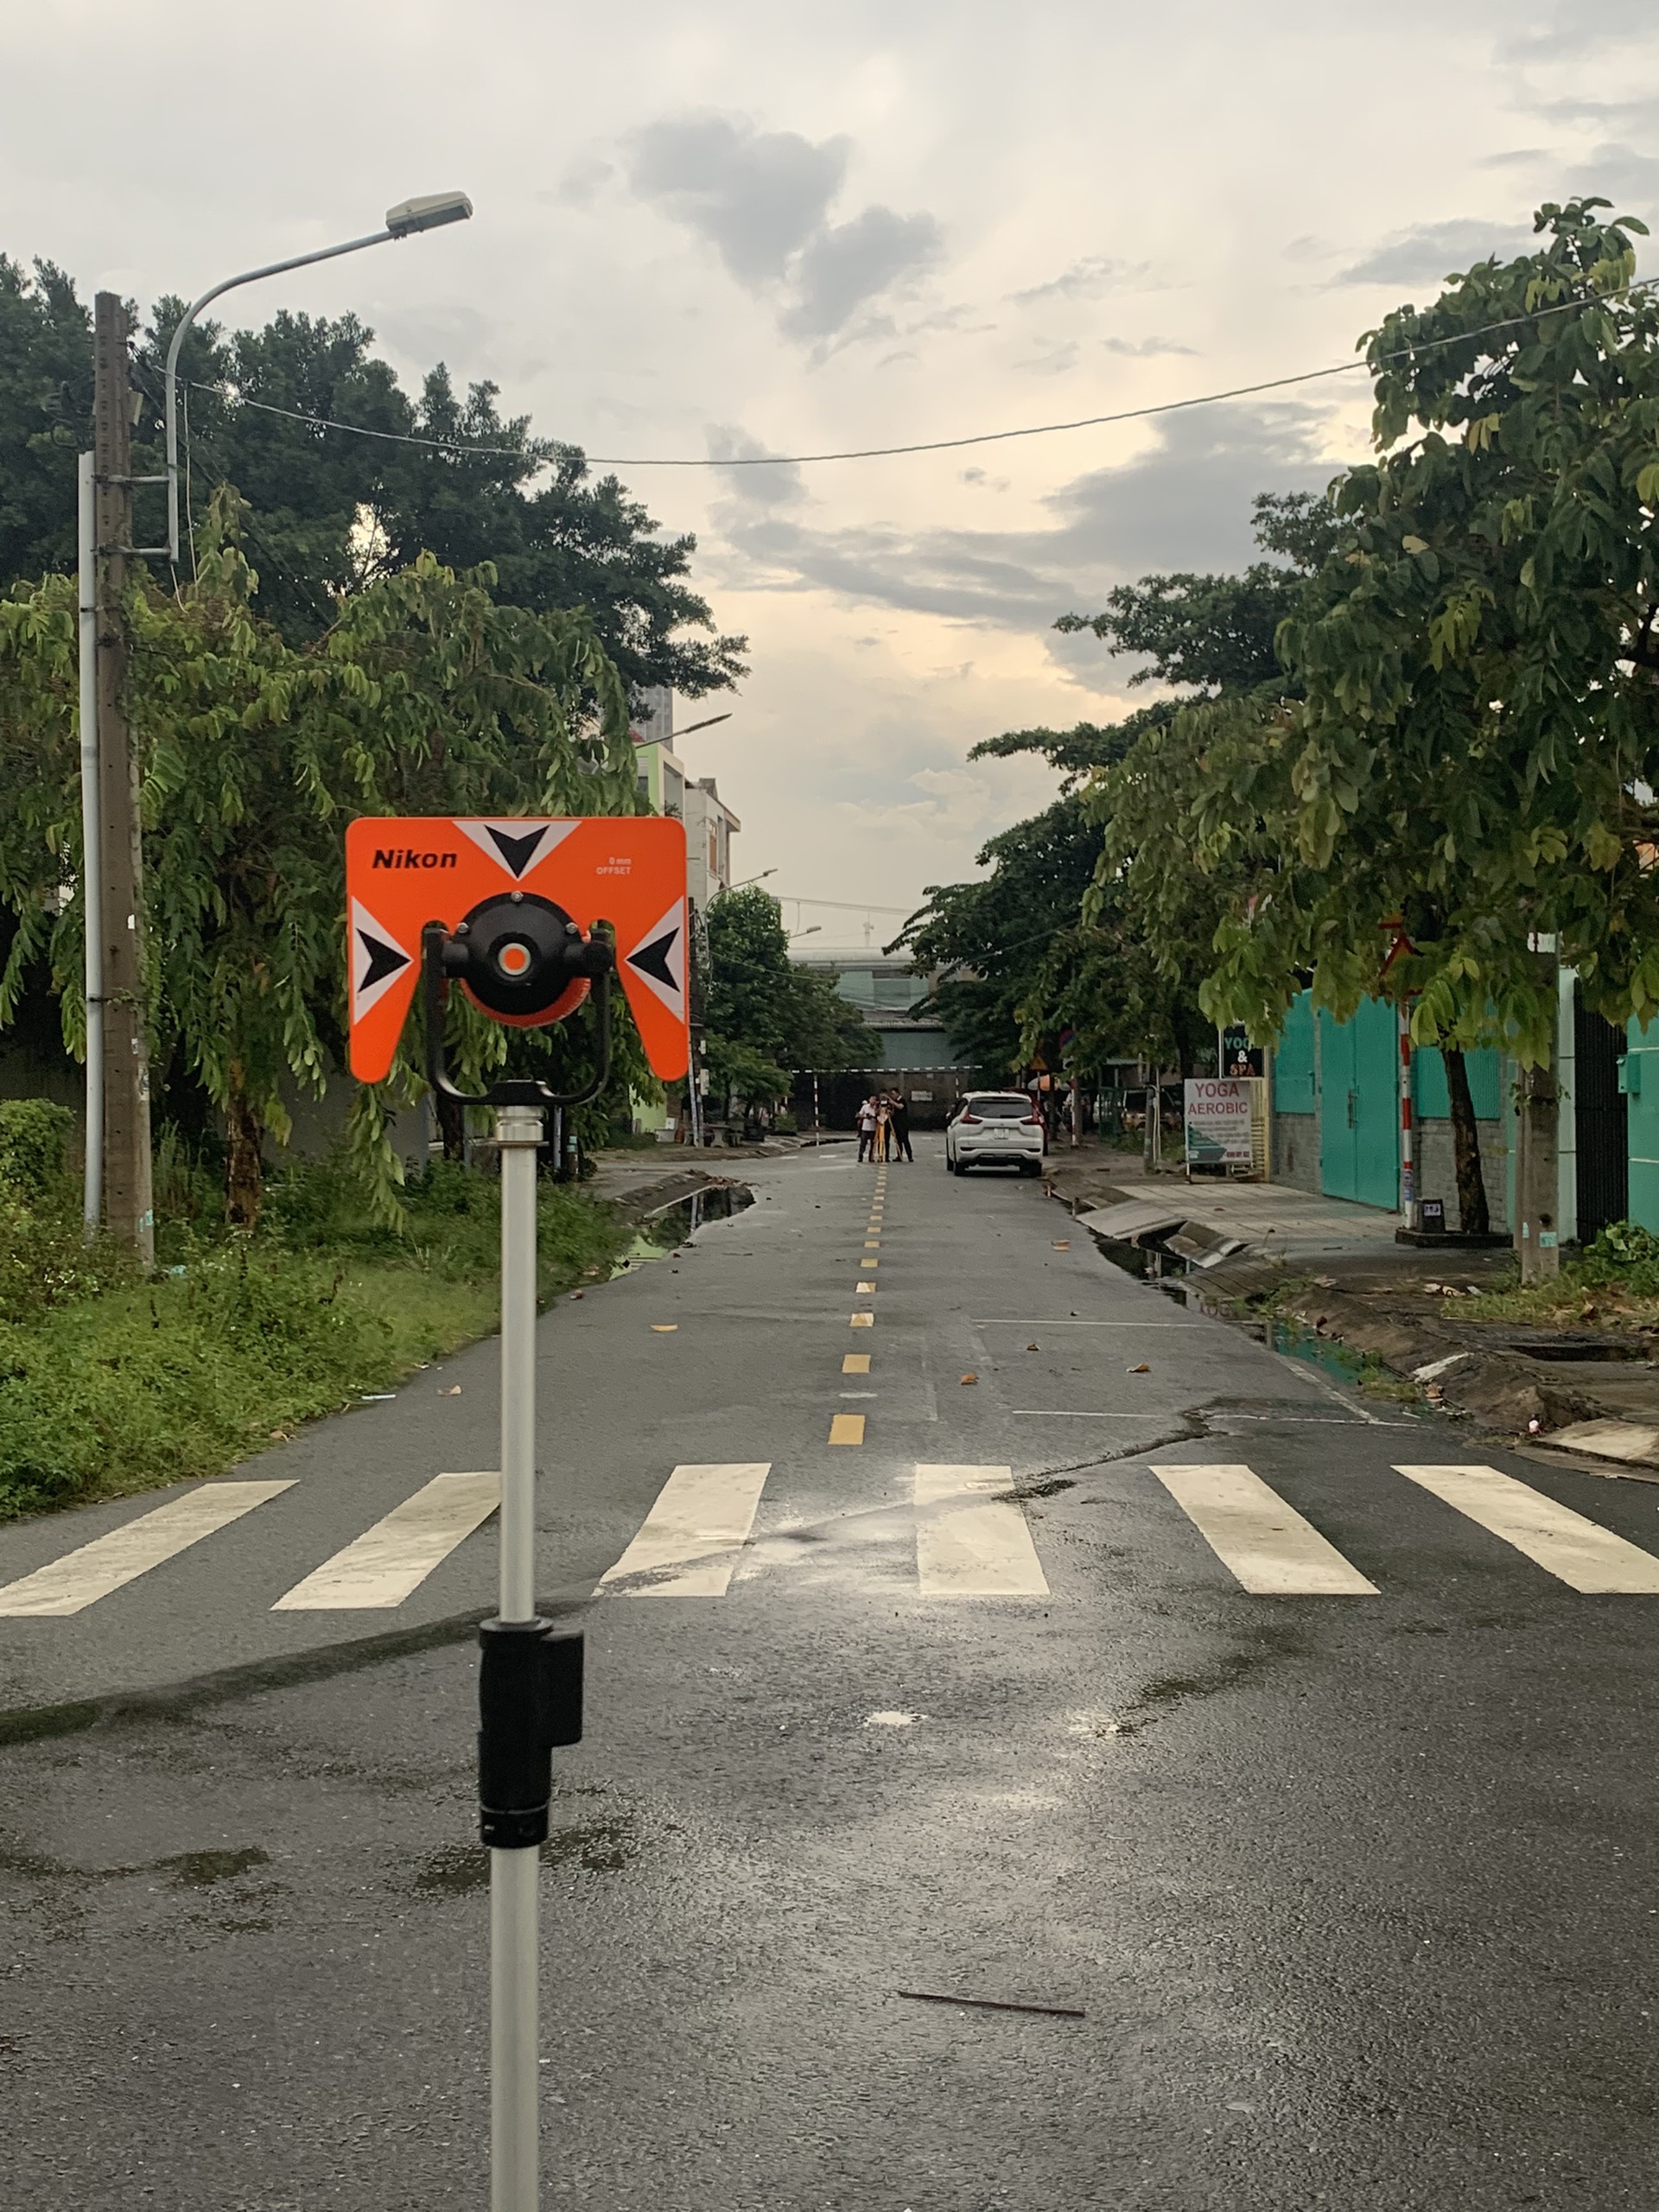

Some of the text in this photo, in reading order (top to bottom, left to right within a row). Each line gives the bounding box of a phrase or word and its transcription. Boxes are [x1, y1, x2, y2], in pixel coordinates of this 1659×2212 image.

[372, 849, 457, 869] Nikon
[595, 866, 632, 874] OFFSET
[1224, 1037, 1252, 1050] YO
[1237, 1050, 1248, 1063] &
[1230, 1064, 1255, 1076] SPA
[1195, 1082, 1239, 1097] YOGA
[1187, 1102, 1248, 1115] AEROBIC
